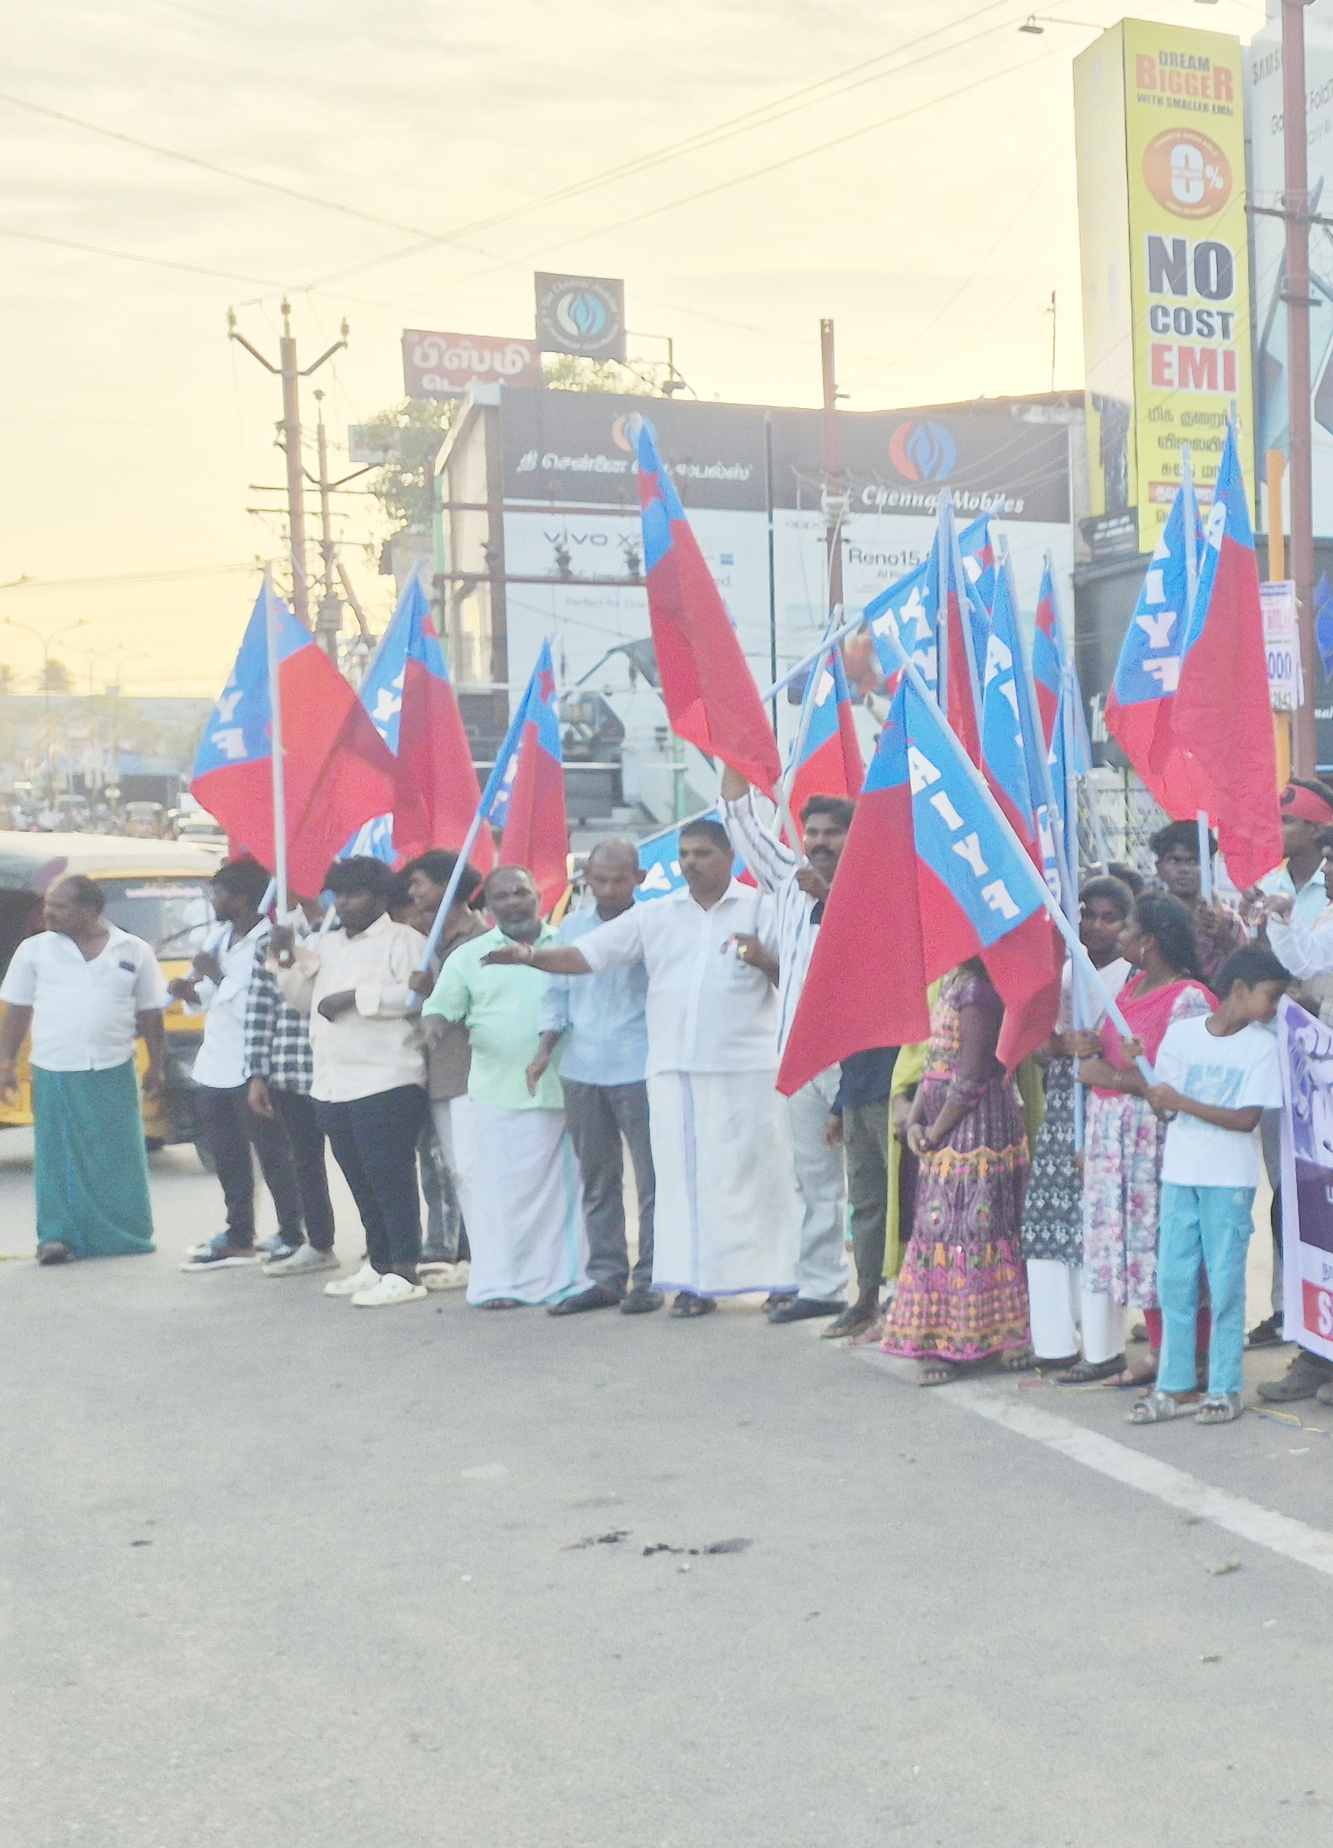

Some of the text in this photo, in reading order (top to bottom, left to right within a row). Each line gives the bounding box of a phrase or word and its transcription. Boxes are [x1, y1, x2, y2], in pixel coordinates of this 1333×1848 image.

[1135, 54, 1235, 103] BIGGER
[1158, 50, 1211, 73] DREAM
[1253, 50, 1281, 86] SAMS
[1147, 235, 1235, 301] NO
[1150, 304, 1236, 341] COST
[1151, 343, 1237, 393] EMI
[543, 527, 609, 547] vivo
